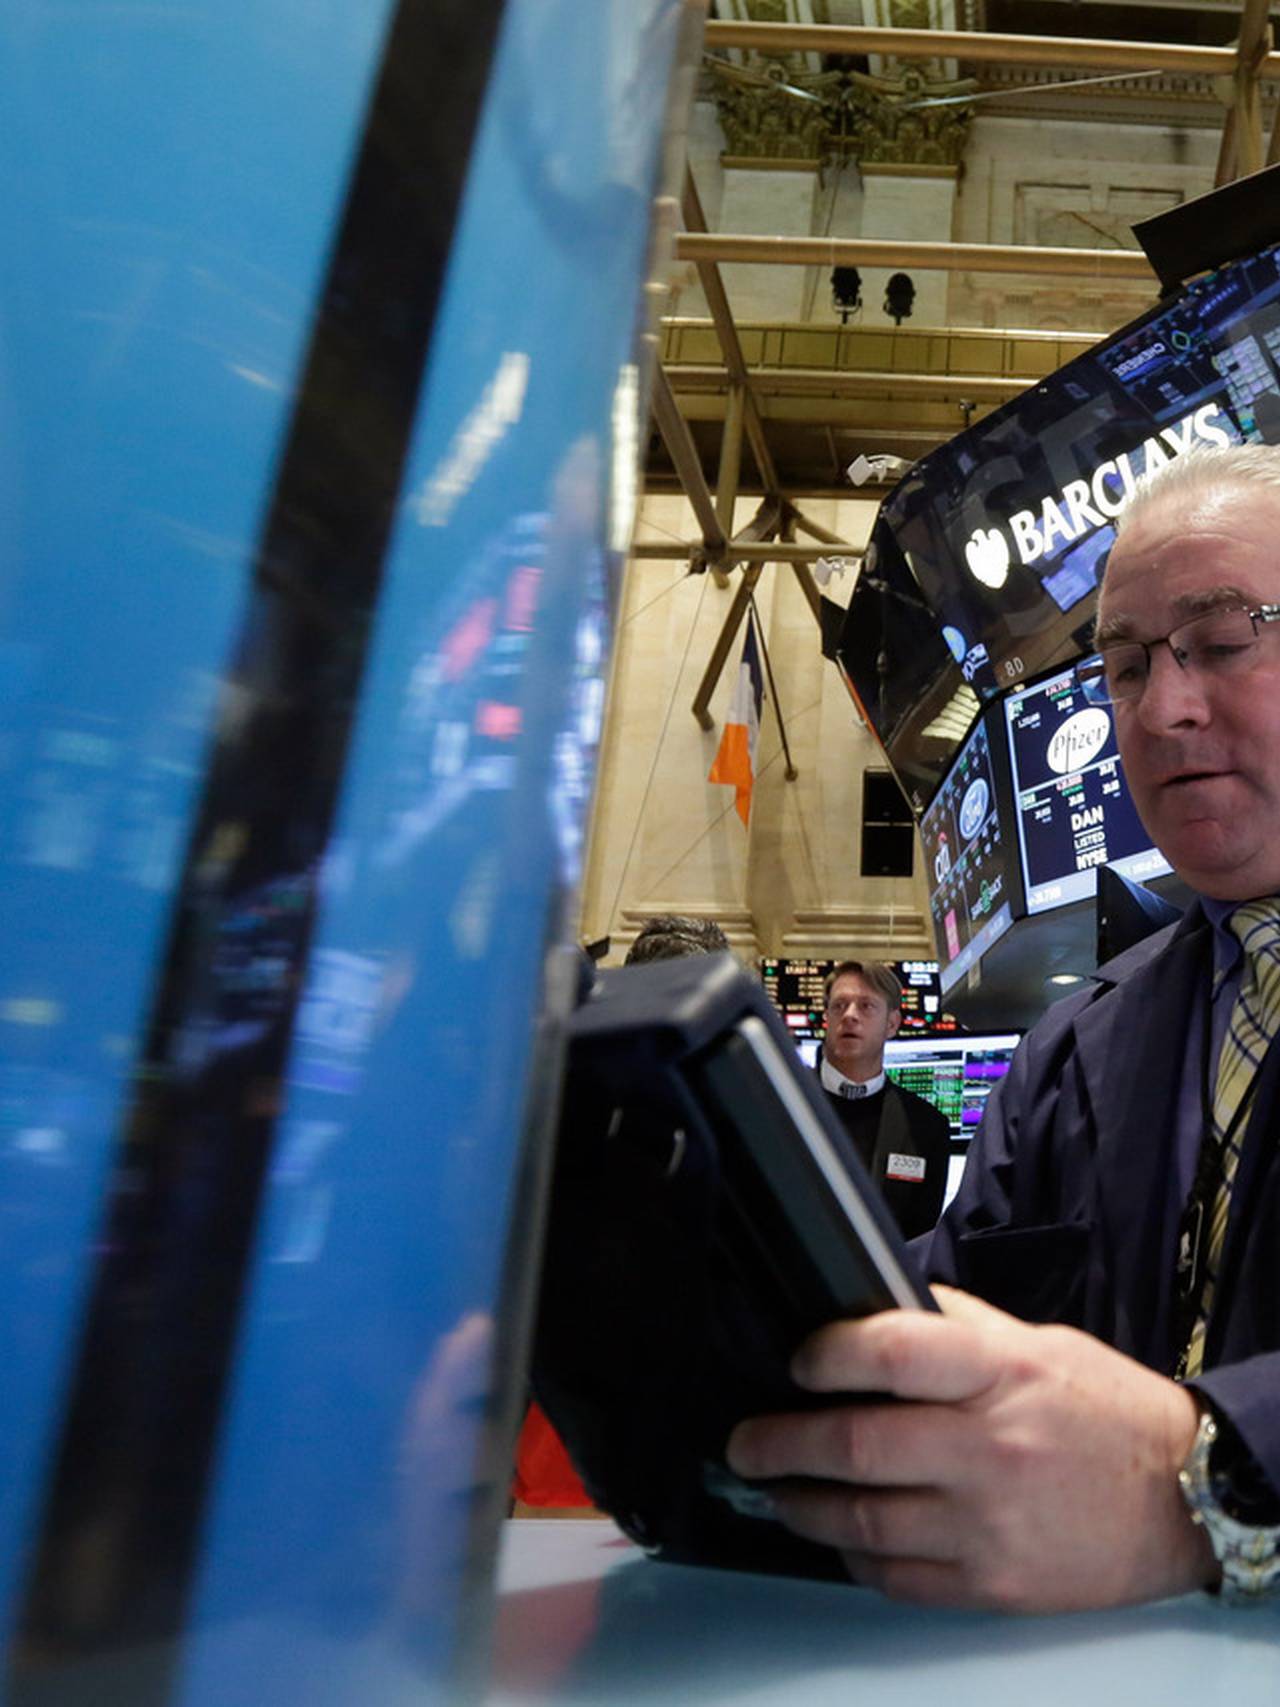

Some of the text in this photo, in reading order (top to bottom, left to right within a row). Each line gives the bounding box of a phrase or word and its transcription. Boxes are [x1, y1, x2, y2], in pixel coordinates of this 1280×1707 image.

[1005, 656, 1025, 678] 8D
[1071, 805, 1104, 831] DAN
[1074, 831, 1105, 849] LISTED
[1076, 848, 1108, 870] NYSE
